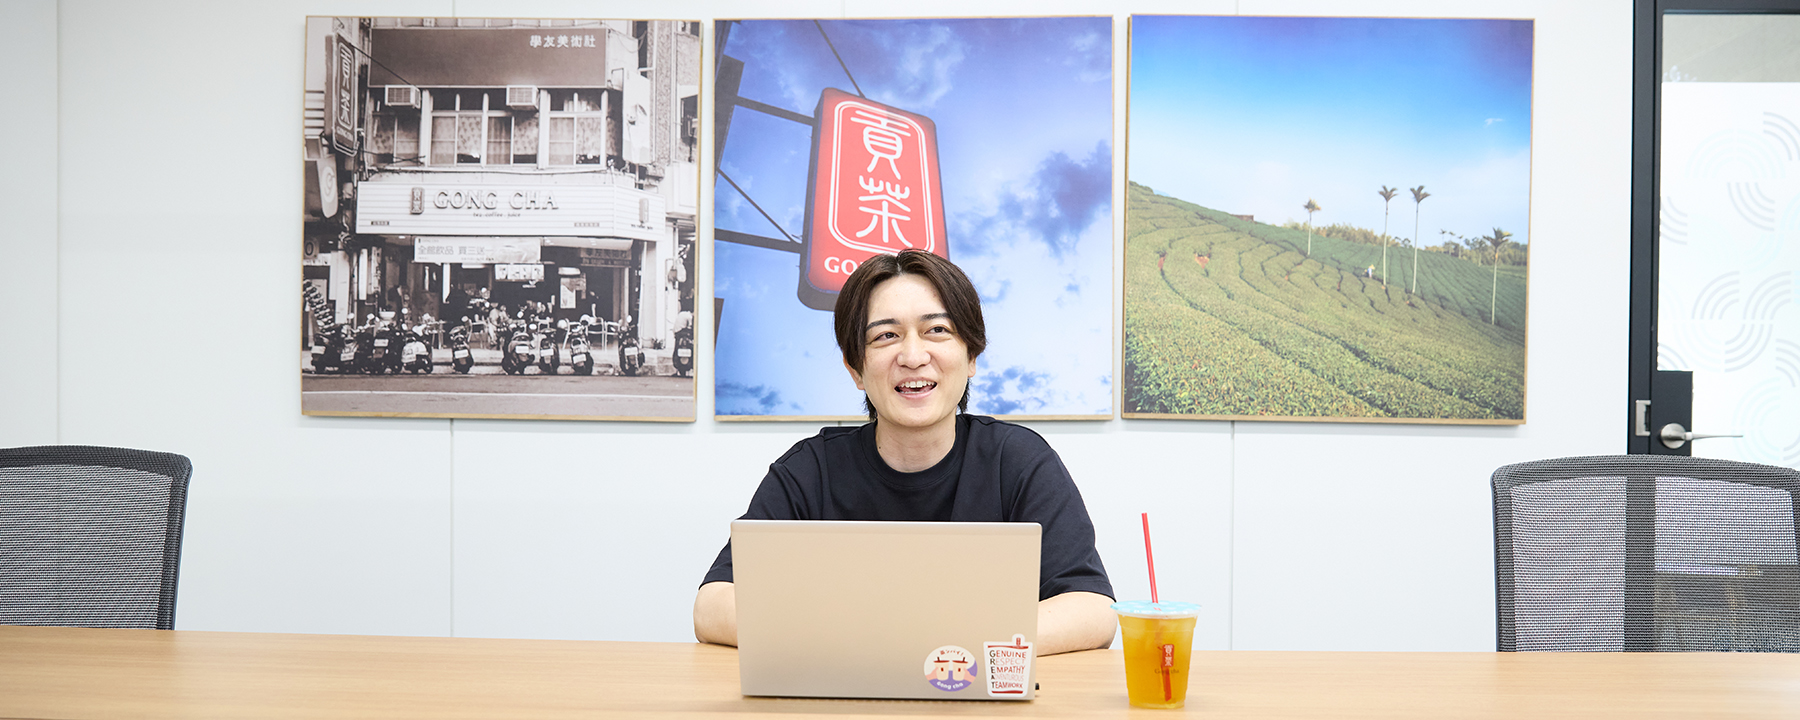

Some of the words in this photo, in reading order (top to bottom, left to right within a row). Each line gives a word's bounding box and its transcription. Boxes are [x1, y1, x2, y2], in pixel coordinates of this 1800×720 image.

[850, 109, 914, 248] 貢茶
[433, 189, 498, 210] GONG
[508, 190, 559, 210] CHA
[824, 256, 863, 276] GO
[989, 649, 1027, 659] GENUINE
[989, 657, 1025, 666] RESPECT
[990, 665, 1025, 675] EMPATHY
[991, 681, 1023, 689] TEAMWORK
